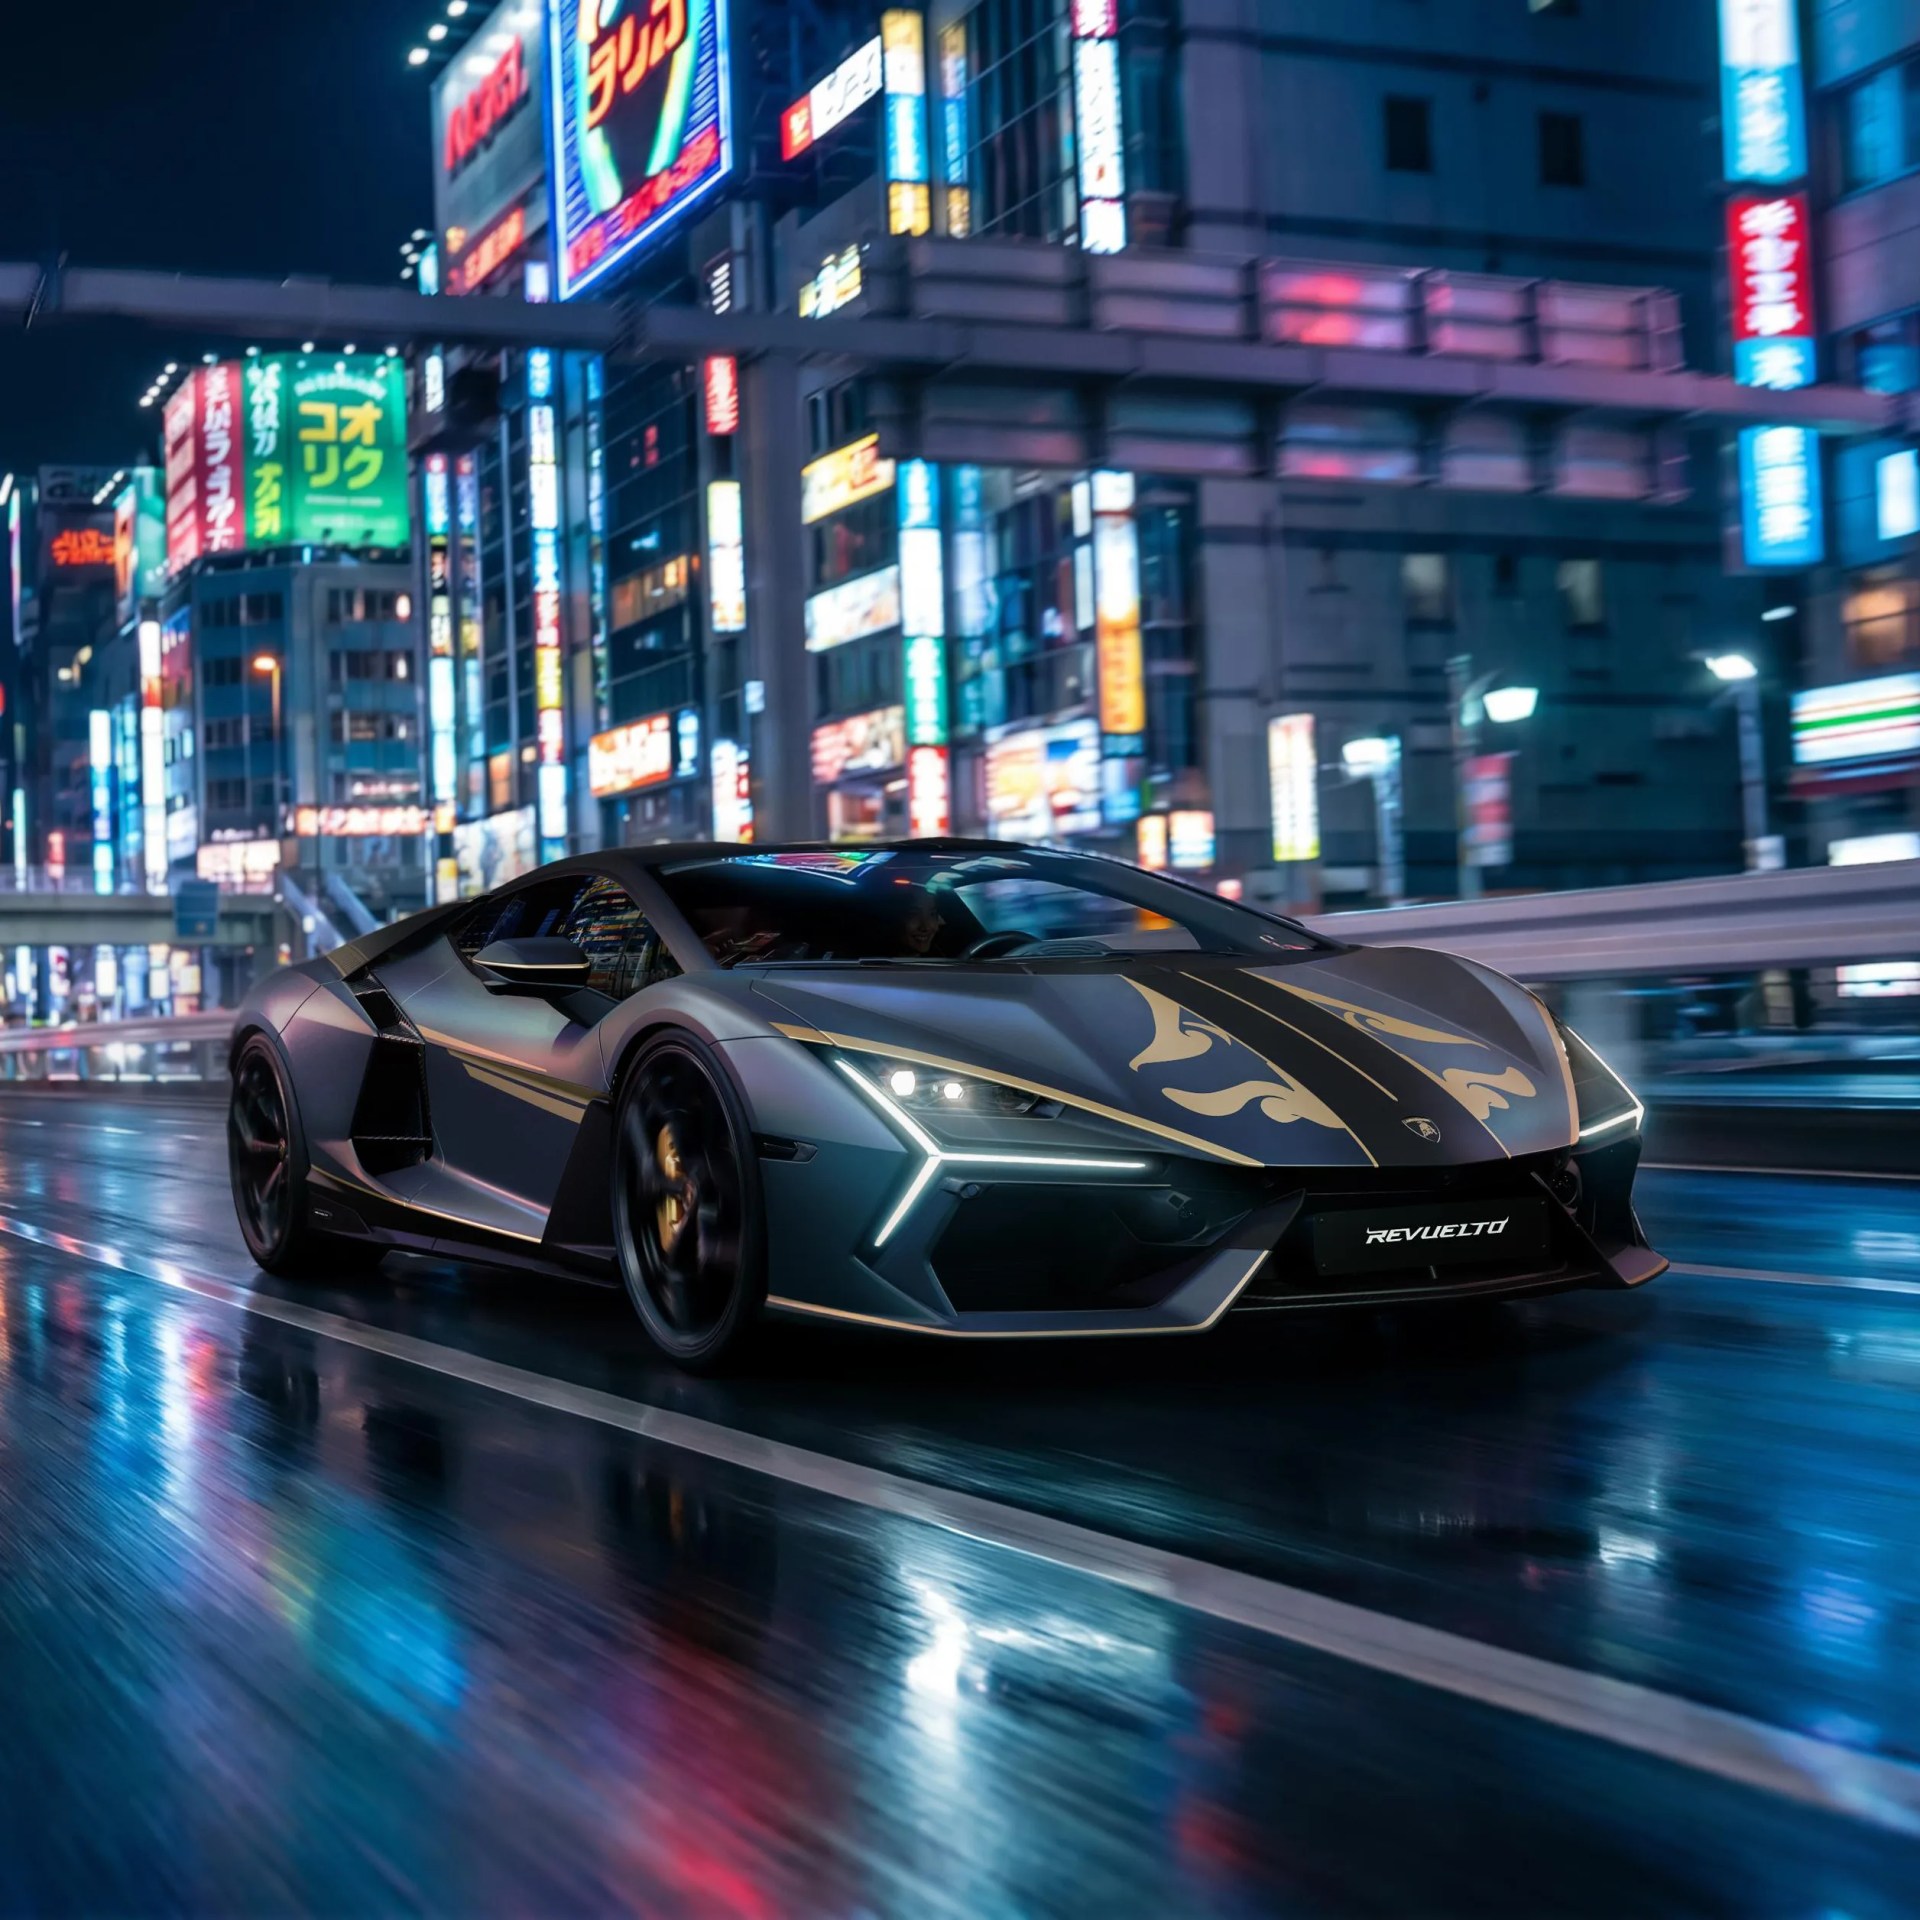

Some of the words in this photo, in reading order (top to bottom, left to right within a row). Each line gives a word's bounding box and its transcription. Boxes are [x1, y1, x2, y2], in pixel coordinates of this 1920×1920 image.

[298, 401, 383, 445] コオ
[303, 446, 383, 490] リク
[1365, 1216, 1510, 1245] REVUELTO
